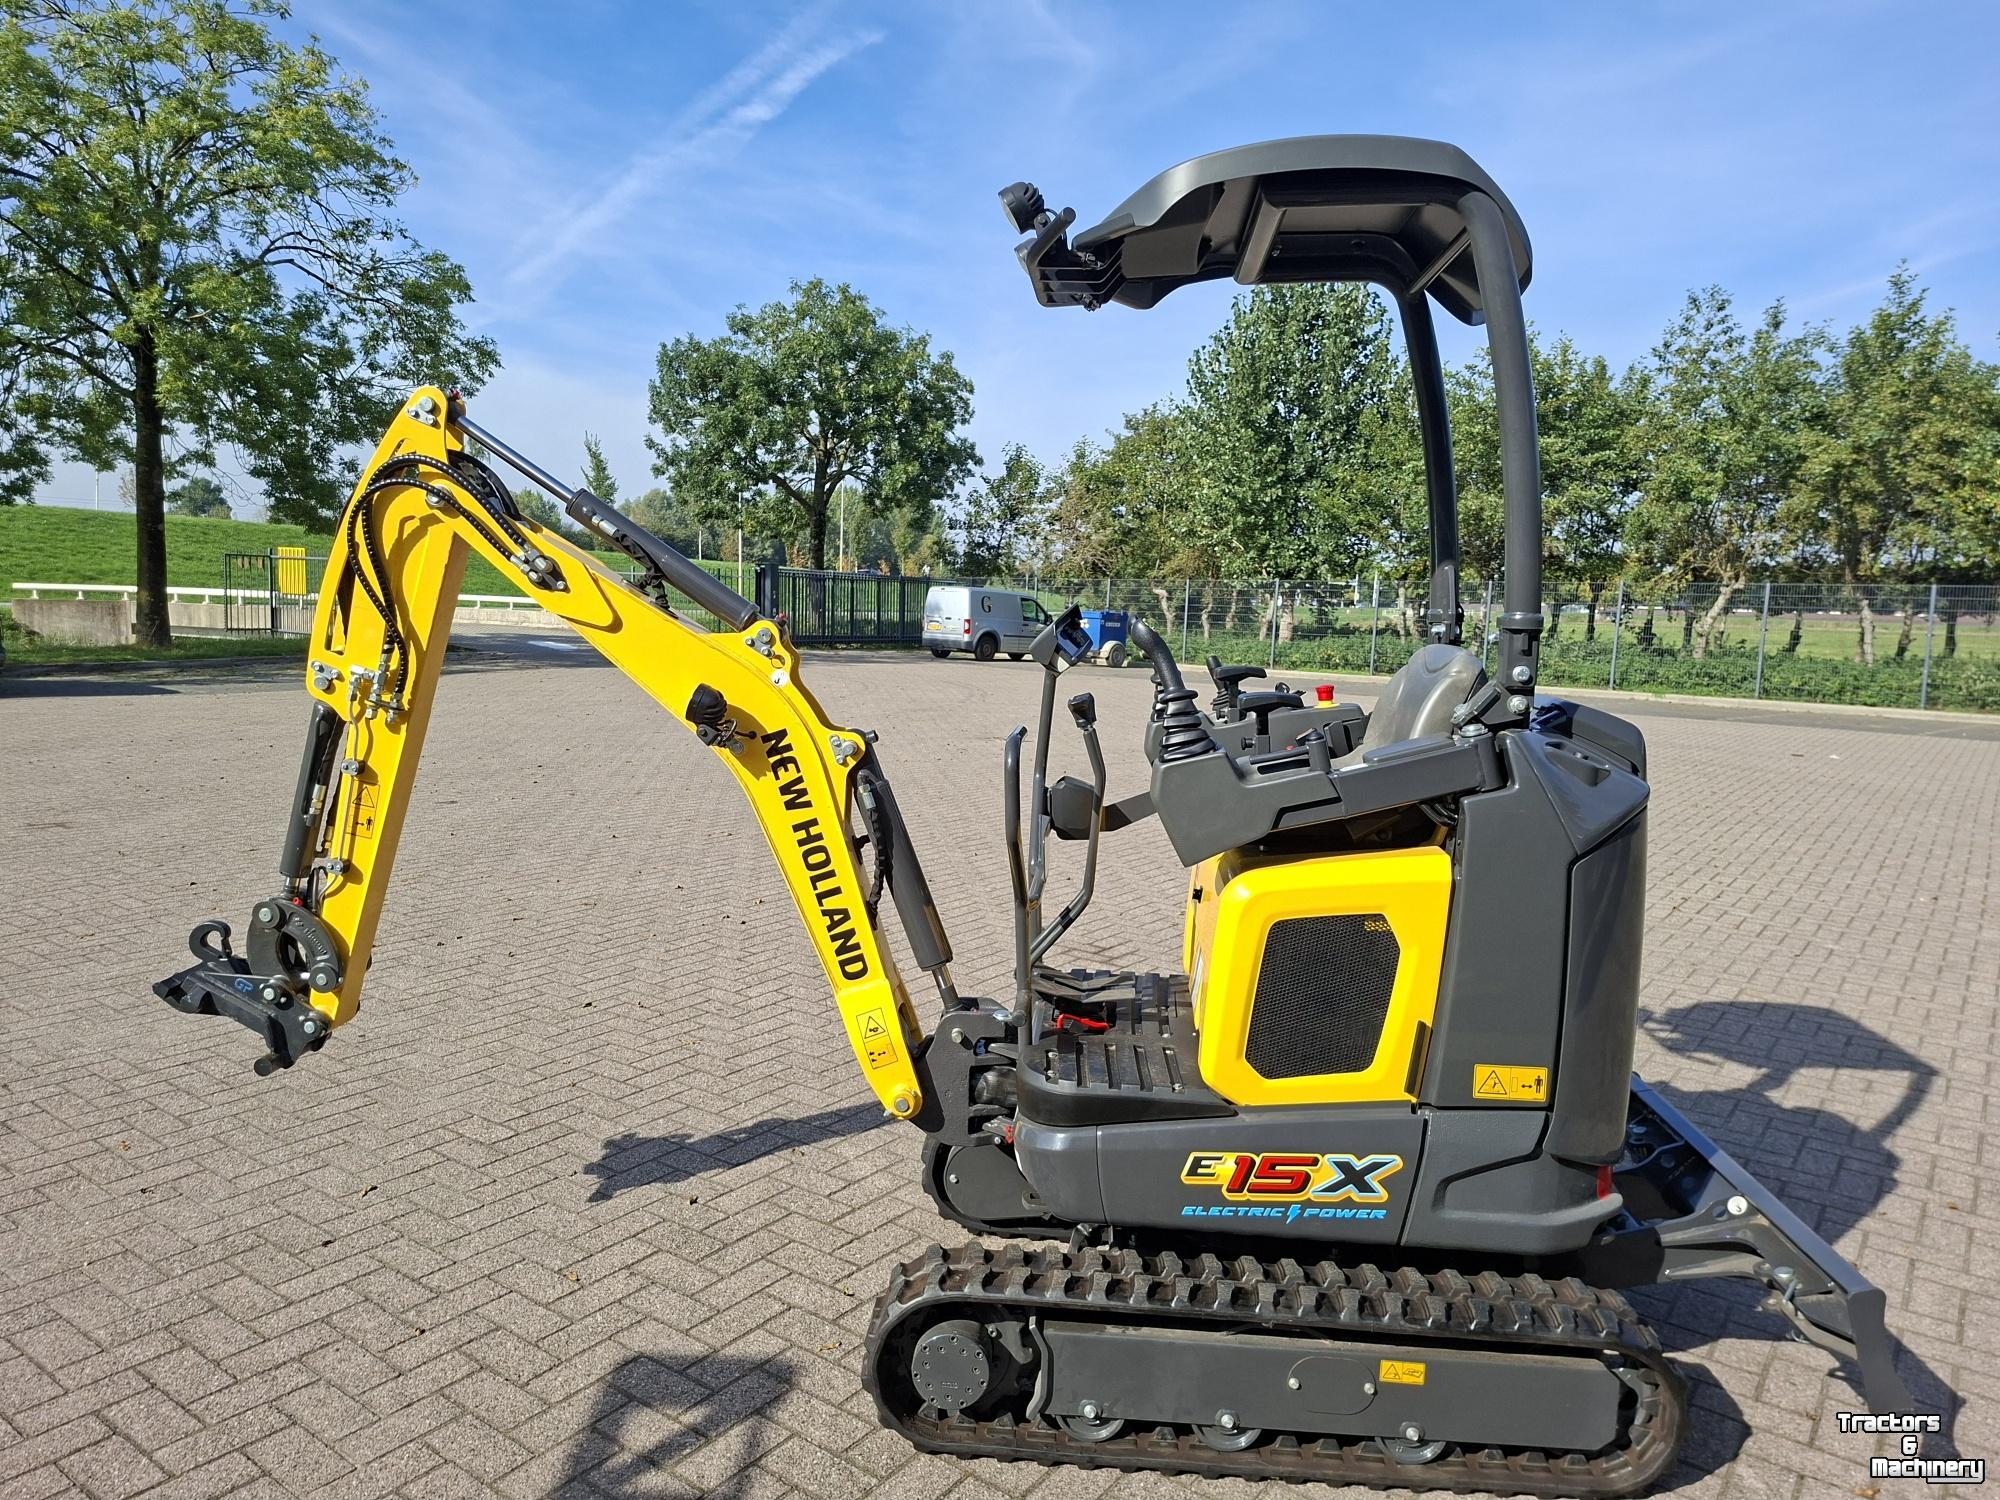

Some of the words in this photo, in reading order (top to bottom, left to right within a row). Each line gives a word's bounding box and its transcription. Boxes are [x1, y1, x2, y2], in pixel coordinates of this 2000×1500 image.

[760, 728, 813, 811] NEW
[791, 817, 869, 981] HOLLAND
[1180, 1205, 1283, 1218] ELECTRIC
[1302, 1208, 1388, 1220] POWER
